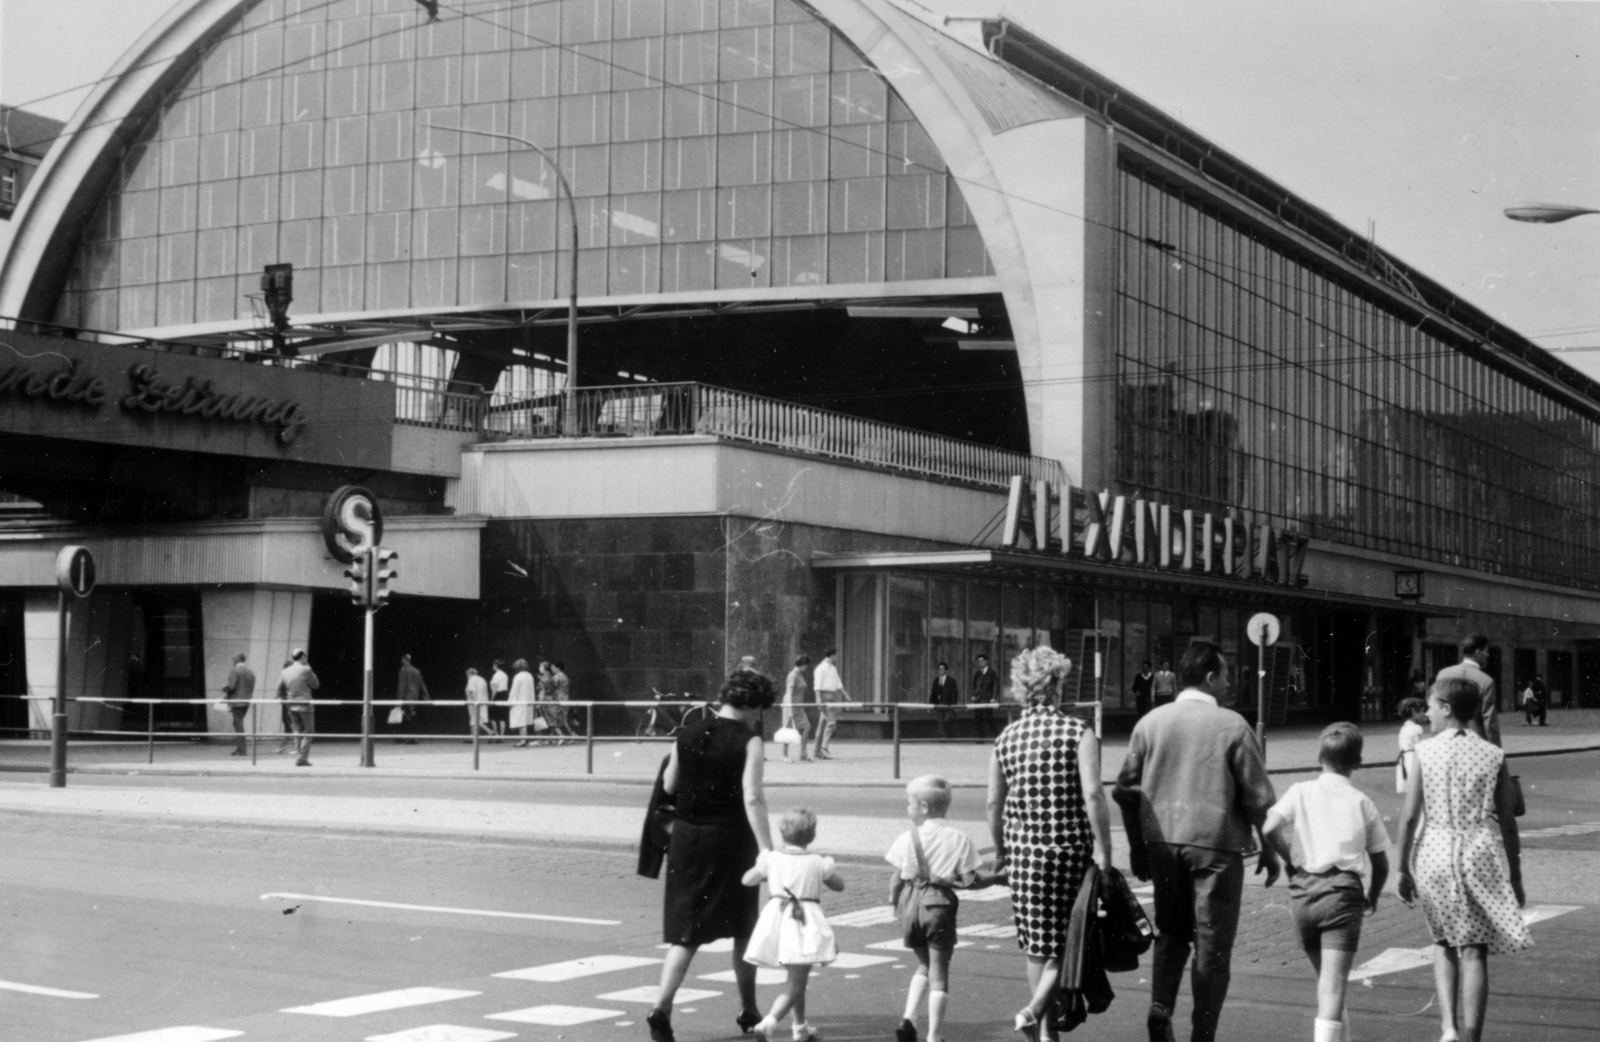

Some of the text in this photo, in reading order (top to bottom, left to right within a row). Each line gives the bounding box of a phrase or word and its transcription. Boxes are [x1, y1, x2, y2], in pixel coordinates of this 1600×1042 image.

[0, 360, 309, 444] nde Zeitung
[334, 494, 374, 553] S
[1002, 474, 1310, 588] ALEXANDERPLATZ
